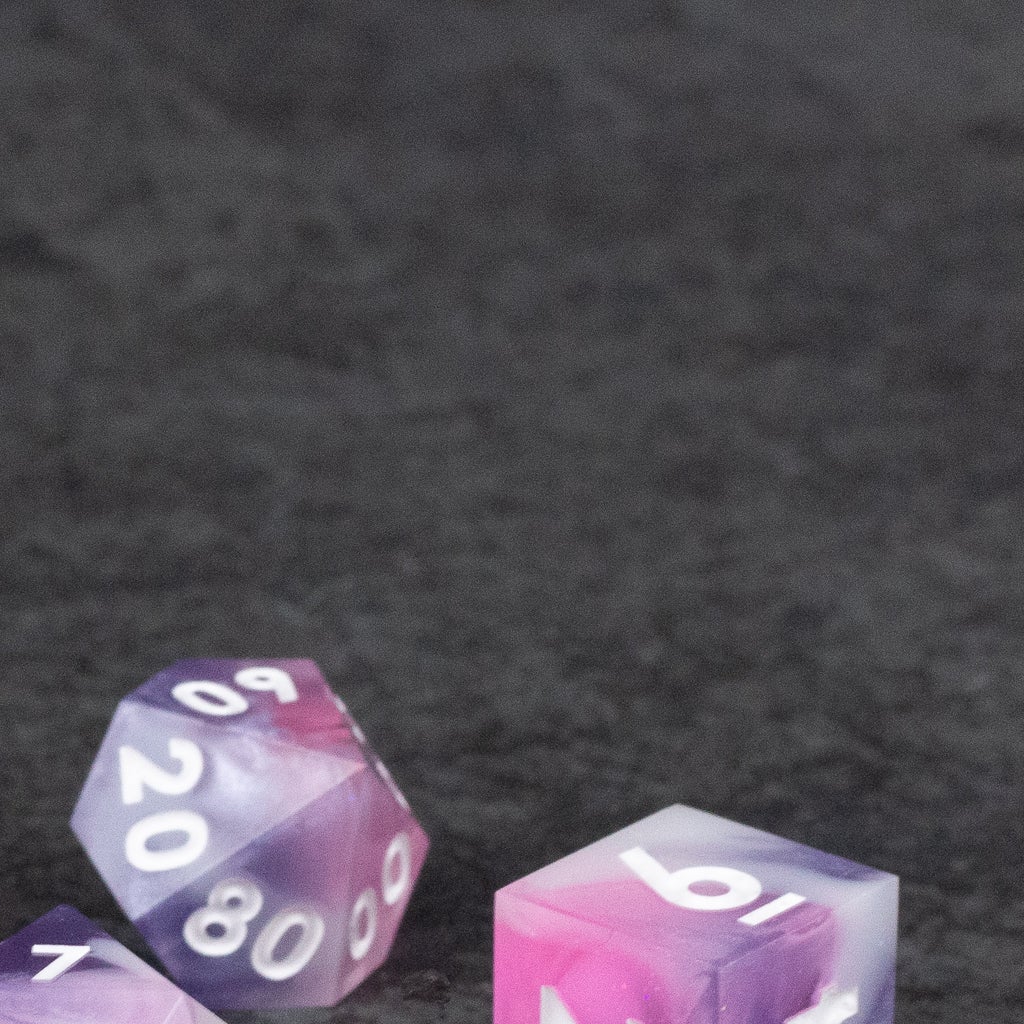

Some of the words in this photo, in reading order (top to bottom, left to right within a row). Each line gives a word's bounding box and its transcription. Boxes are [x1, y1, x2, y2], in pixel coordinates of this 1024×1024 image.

[119, 738, 209, 872] 20
[31, 944, 91, 982] 7
[183, 876, 325, 981] 80
